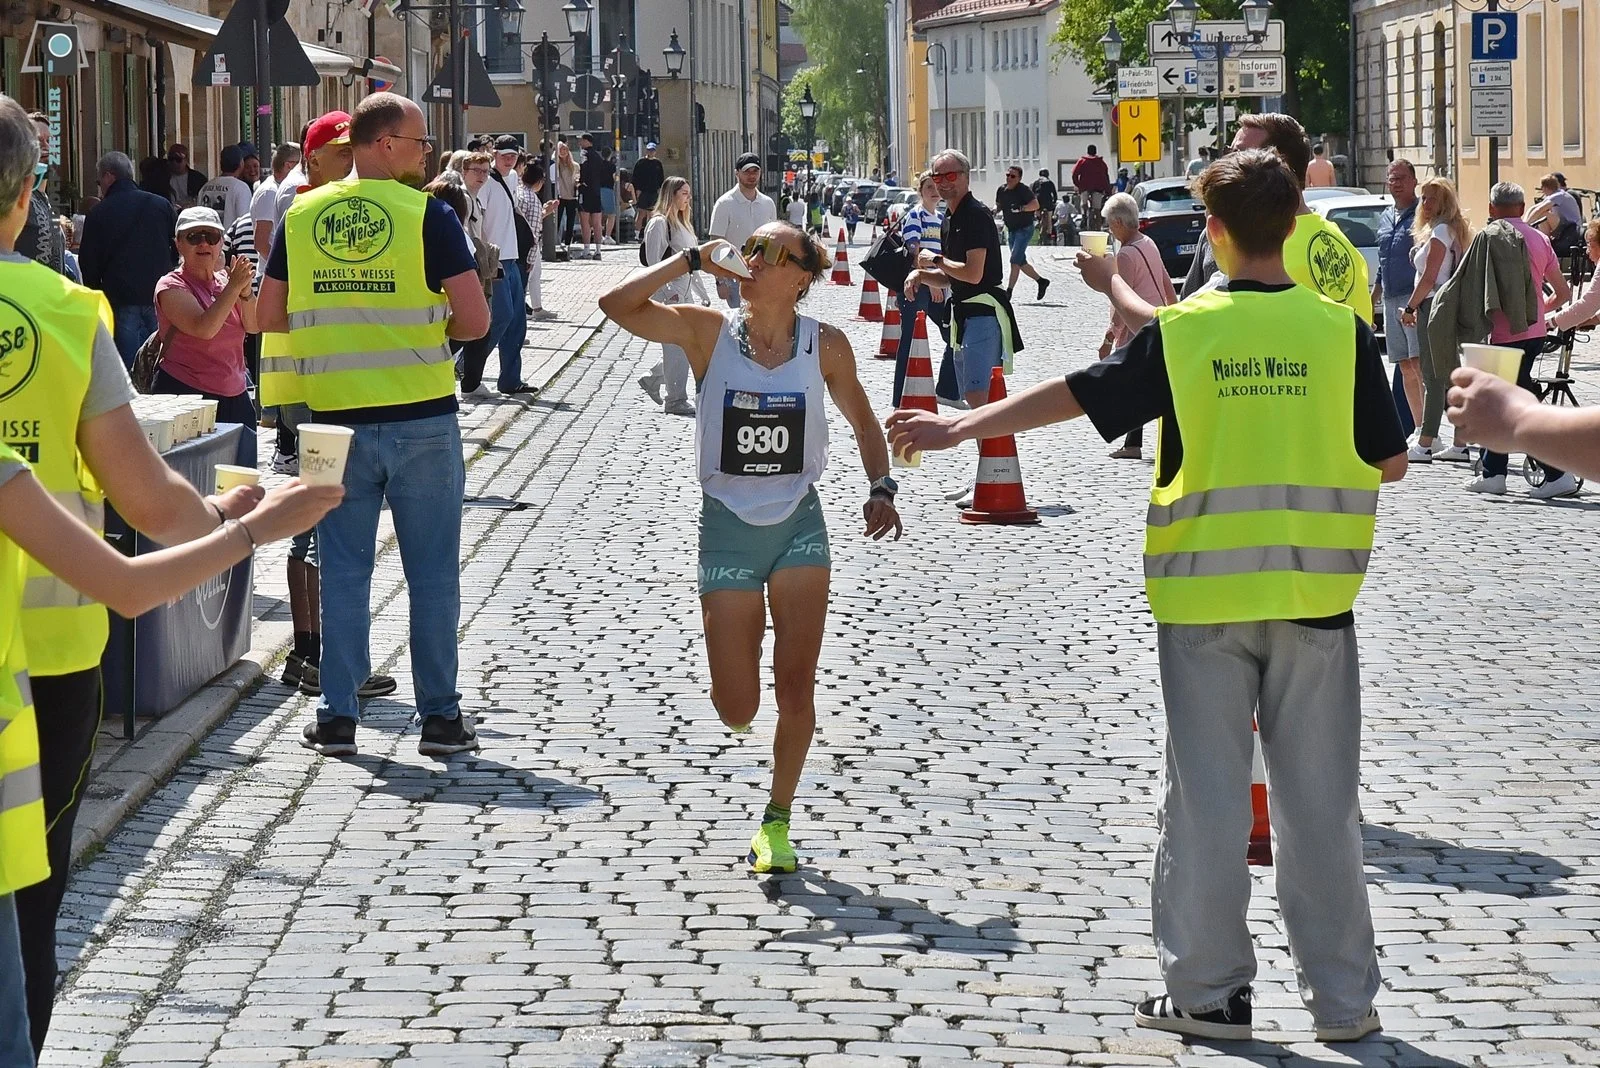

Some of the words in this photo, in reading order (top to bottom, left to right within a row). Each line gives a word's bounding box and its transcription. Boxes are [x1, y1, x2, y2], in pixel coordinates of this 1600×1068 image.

[1206, 33, 1247, 42] Uneres
[1482, 18, 1507, 54] P
[1239, 61, 1277, 71] hsforum
[1127, 80, 1157, 88] Friedrichs-
[1130, 87, 1147, 95] forum
[1129, 105, 1140, 118] U
[48, 87, 61, 165] ZIEGLER
[320, 202, 370, 245] Maisel's
[342, 218, 386, 248] Weisse
[313, 268, 356, 279] MAISEL'S
[360, 269, 395, 279] WEISSE
[318, 282, 391, 292] ALKOHOLFREI
[1212, 357, 1261, 381] Maisel's
[1264, 357, 1308, 378] Weisse
[1217, 385, 1307, 398] ALKOHOLFREI
[737, 425, 789, 454] 930
[742, 463, 782, 474] cep
[702, 567, 754, 581] NIKE
